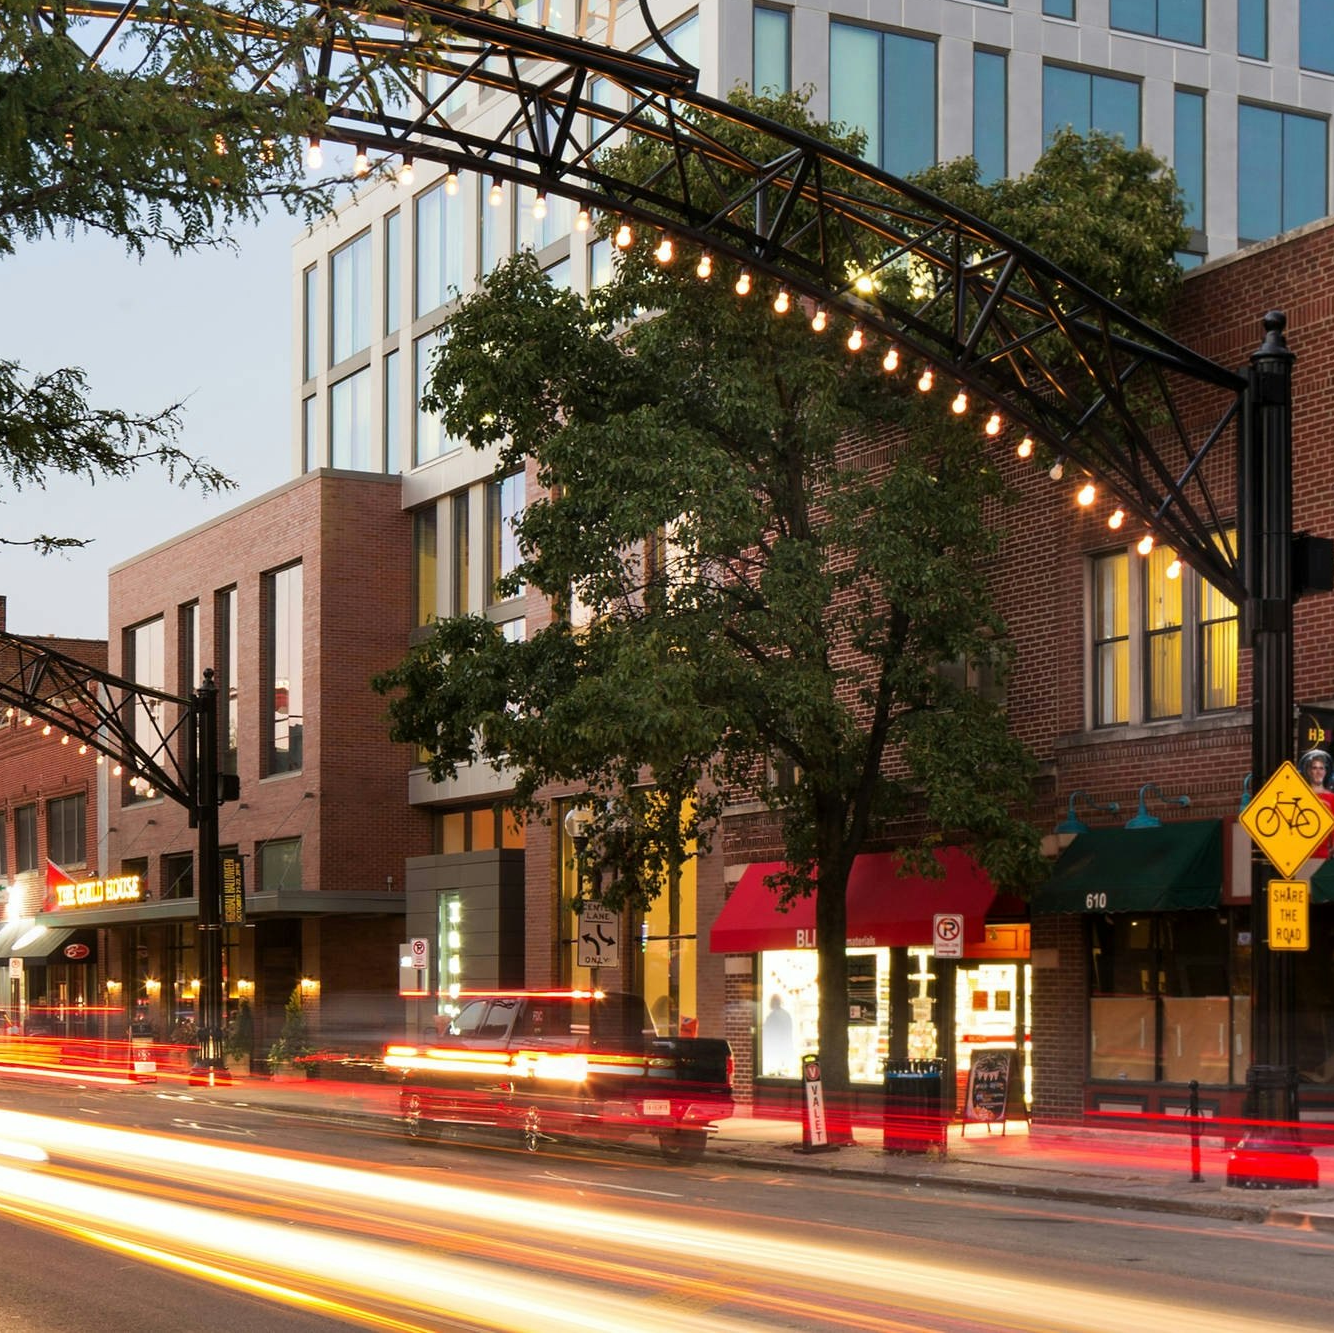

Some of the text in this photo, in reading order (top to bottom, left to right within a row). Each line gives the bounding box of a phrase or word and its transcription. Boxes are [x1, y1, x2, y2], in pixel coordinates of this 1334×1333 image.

[56, 875, 140, 906] THE GUILD HOUSE
[1273, 889, 1304, 903] SHARE
[1085, 893, 1107, 909] 610
[587, 912, 610, 920] LANE
[1280, 908, 1298, 922] THE
[796, 929, 817, 948] BLI
[1276, 927, 1301, 941] ROAD
[585, 956, 609, 965] ONLY
[809, 1069, 816, 1078] V
[811, 1085, 823, 1143] VALET
